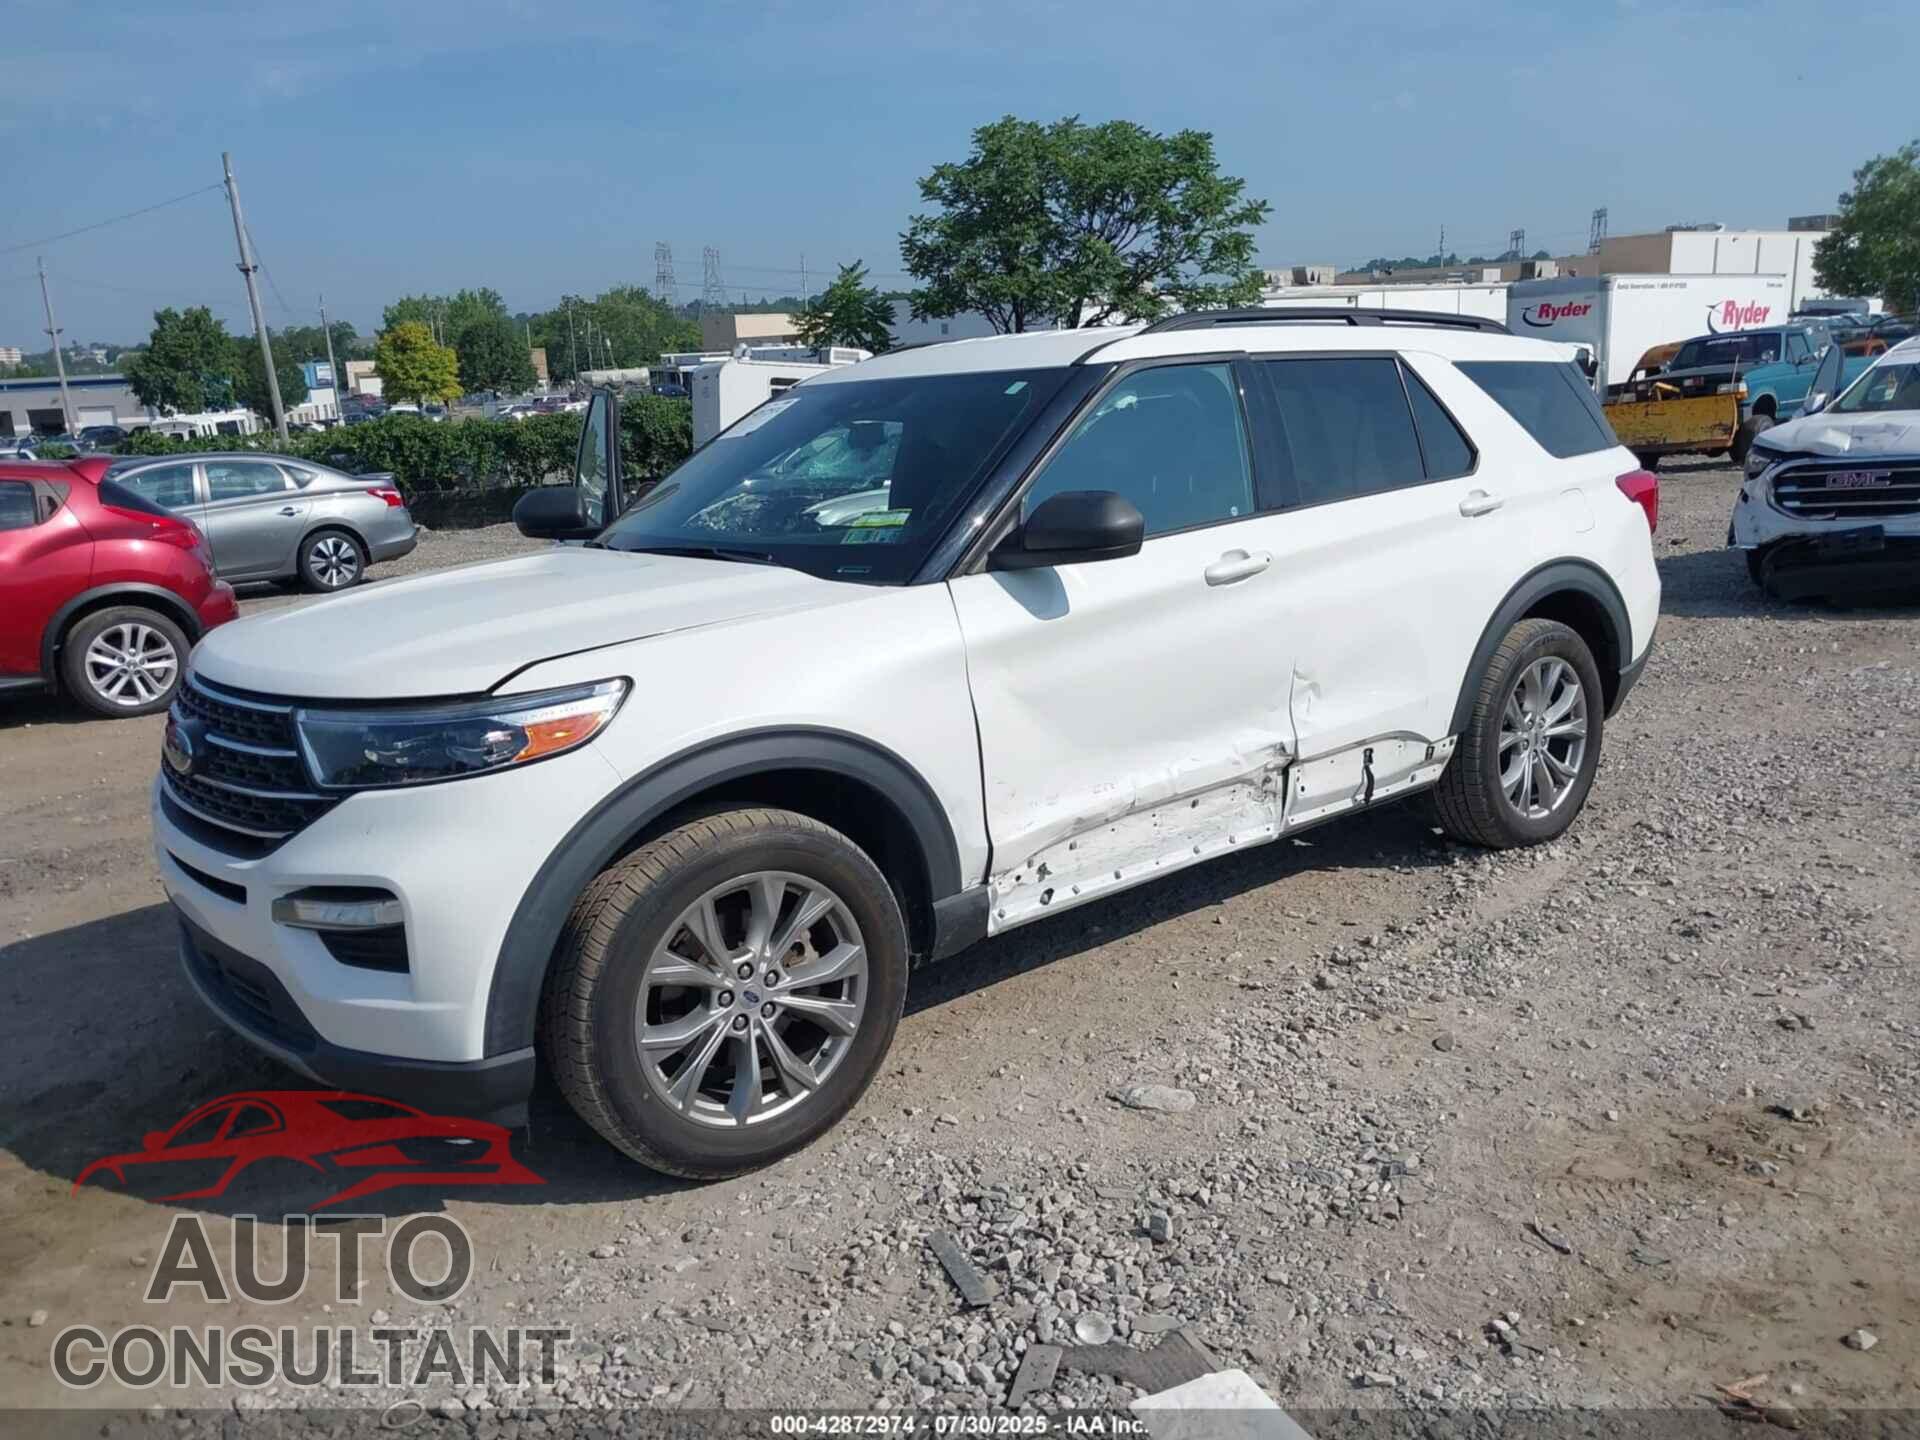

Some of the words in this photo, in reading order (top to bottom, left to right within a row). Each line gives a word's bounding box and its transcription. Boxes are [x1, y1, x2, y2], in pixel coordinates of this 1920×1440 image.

[1537, 301, 1592, 321] Ryder
[1722, 299, 1771, 330] Ryder
[1826, 470, 1893, 488] GMC
